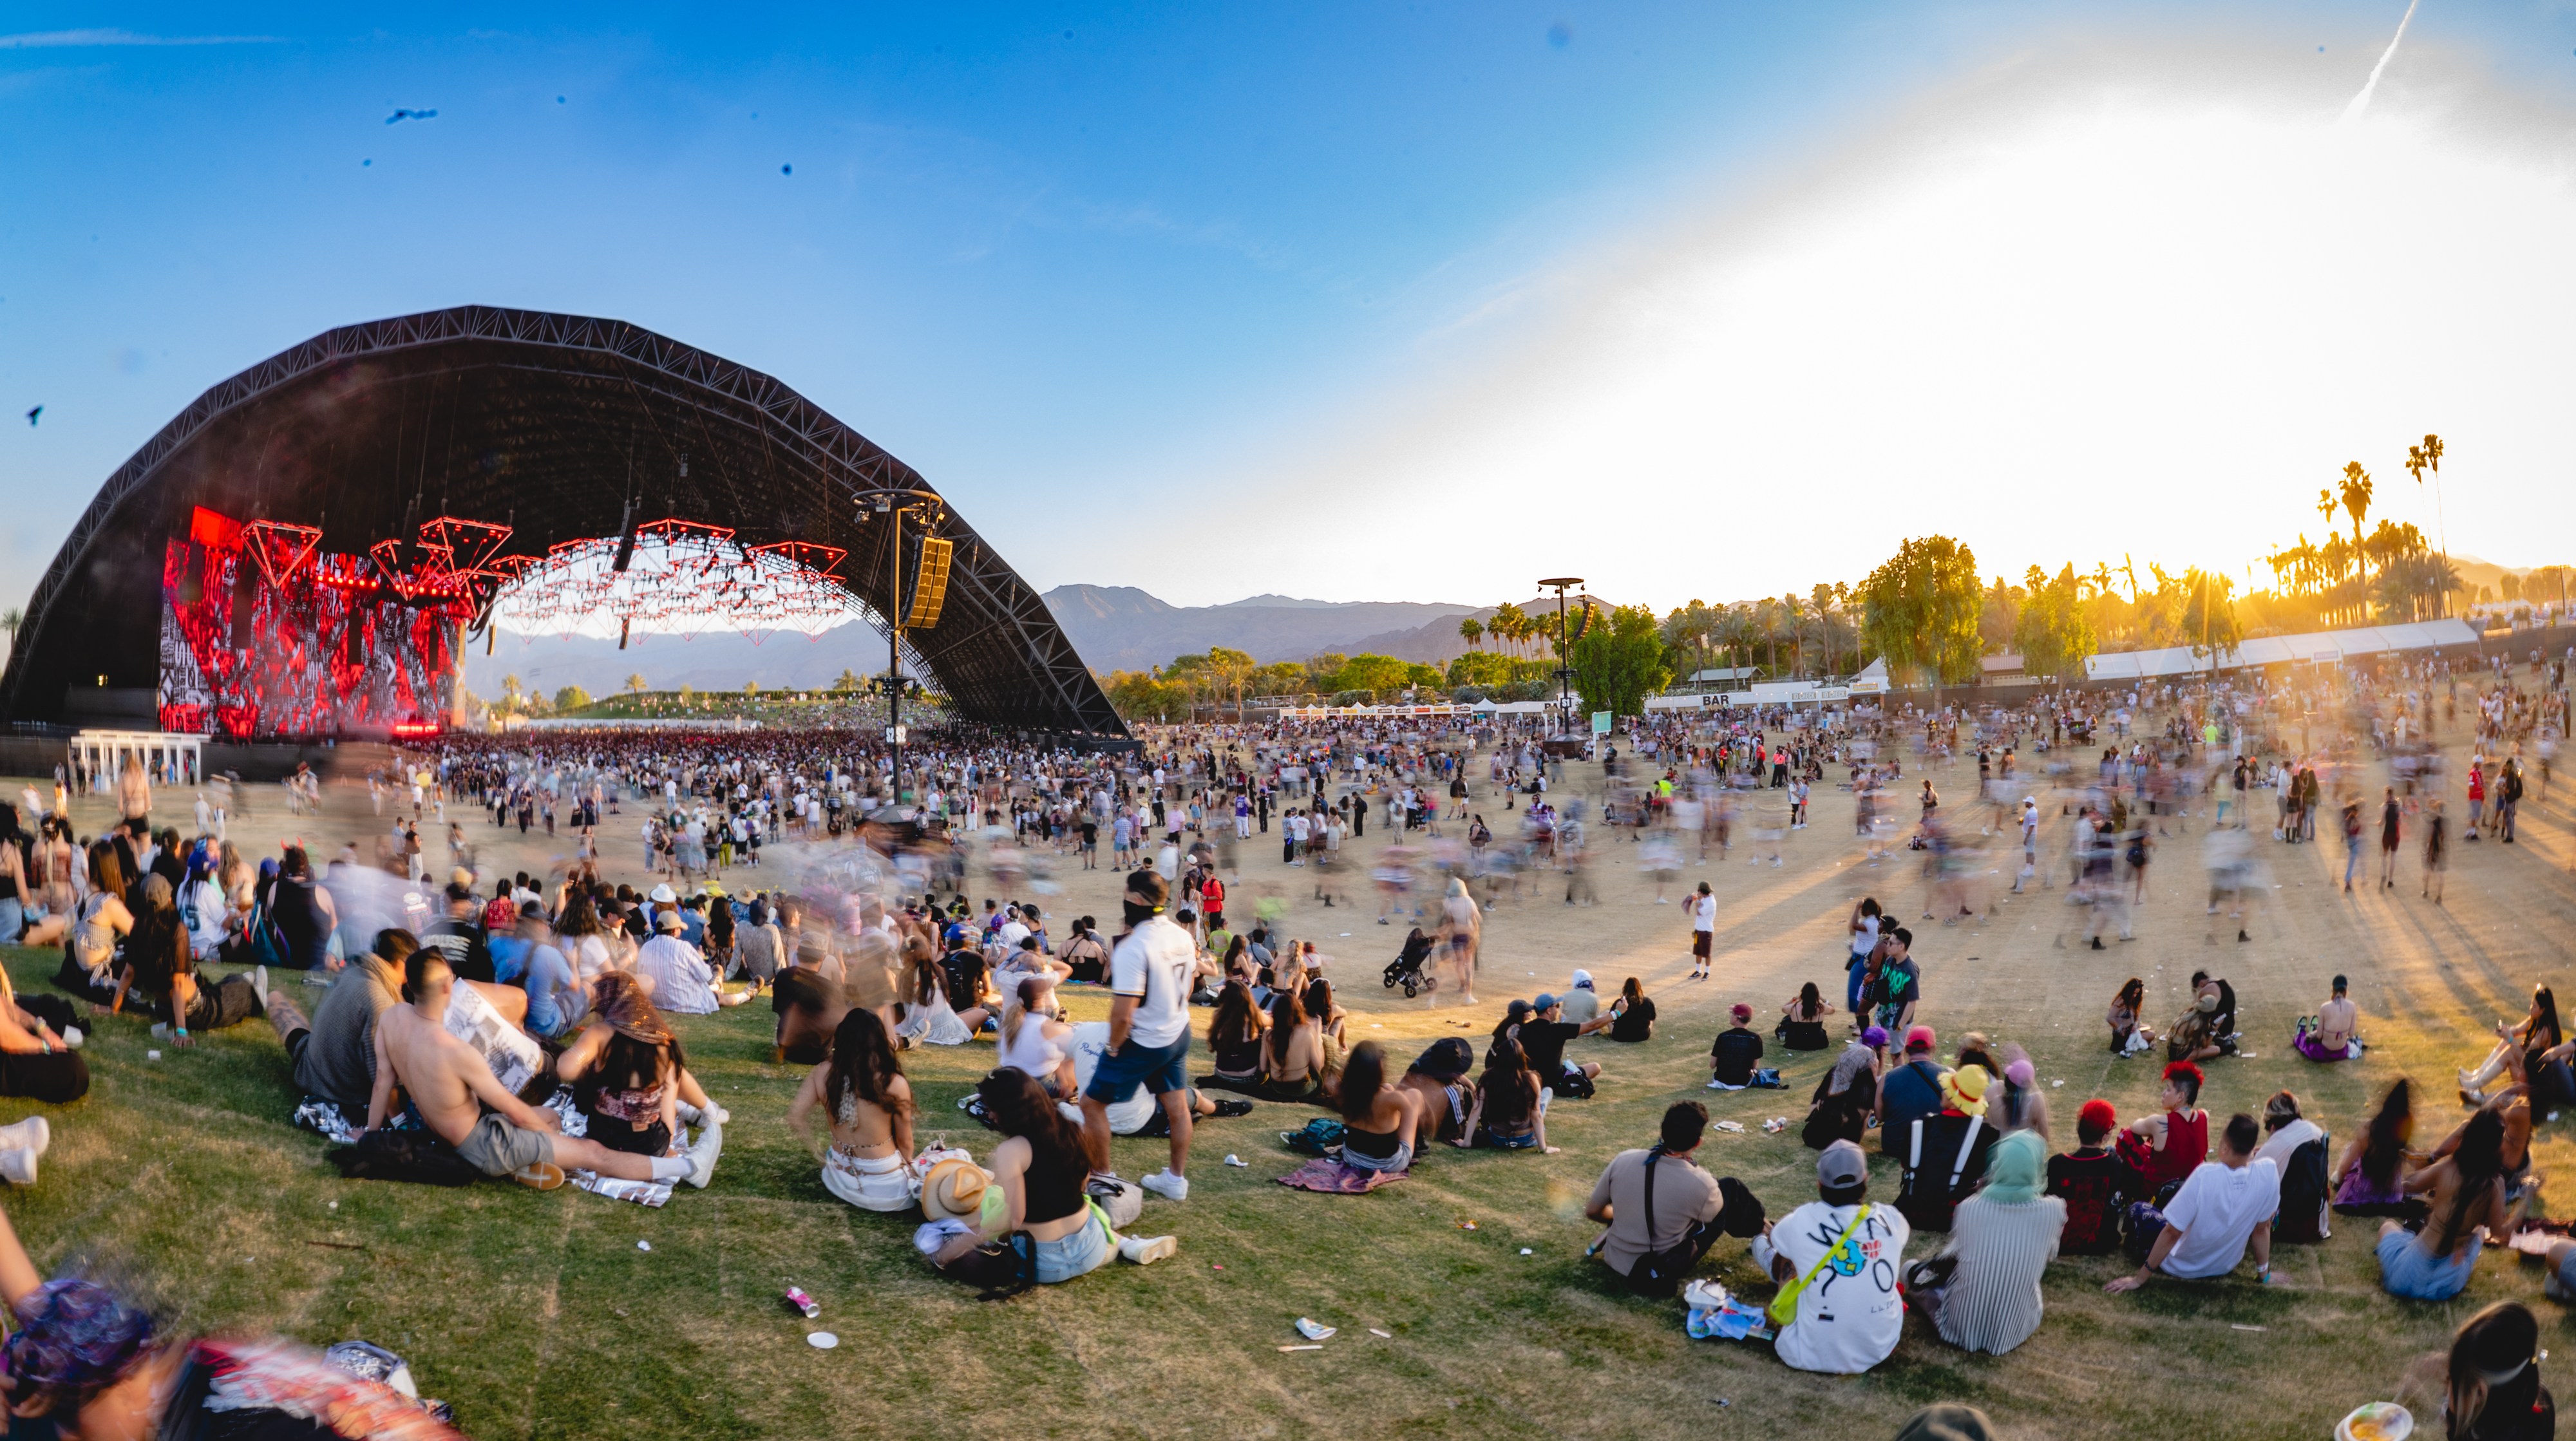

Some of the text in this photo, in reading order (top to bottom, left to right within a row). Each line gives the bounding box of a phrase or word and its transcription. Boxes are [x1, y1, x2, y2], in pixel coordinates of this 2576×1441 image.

[1703, 695, 1729, 706] BAR
[1799, 692, 1815, 700] CHECK
[1562, 698, 1570, 707] S1
[886, 727, 895, 742] S2
[896, 726, 906, 742] S2
